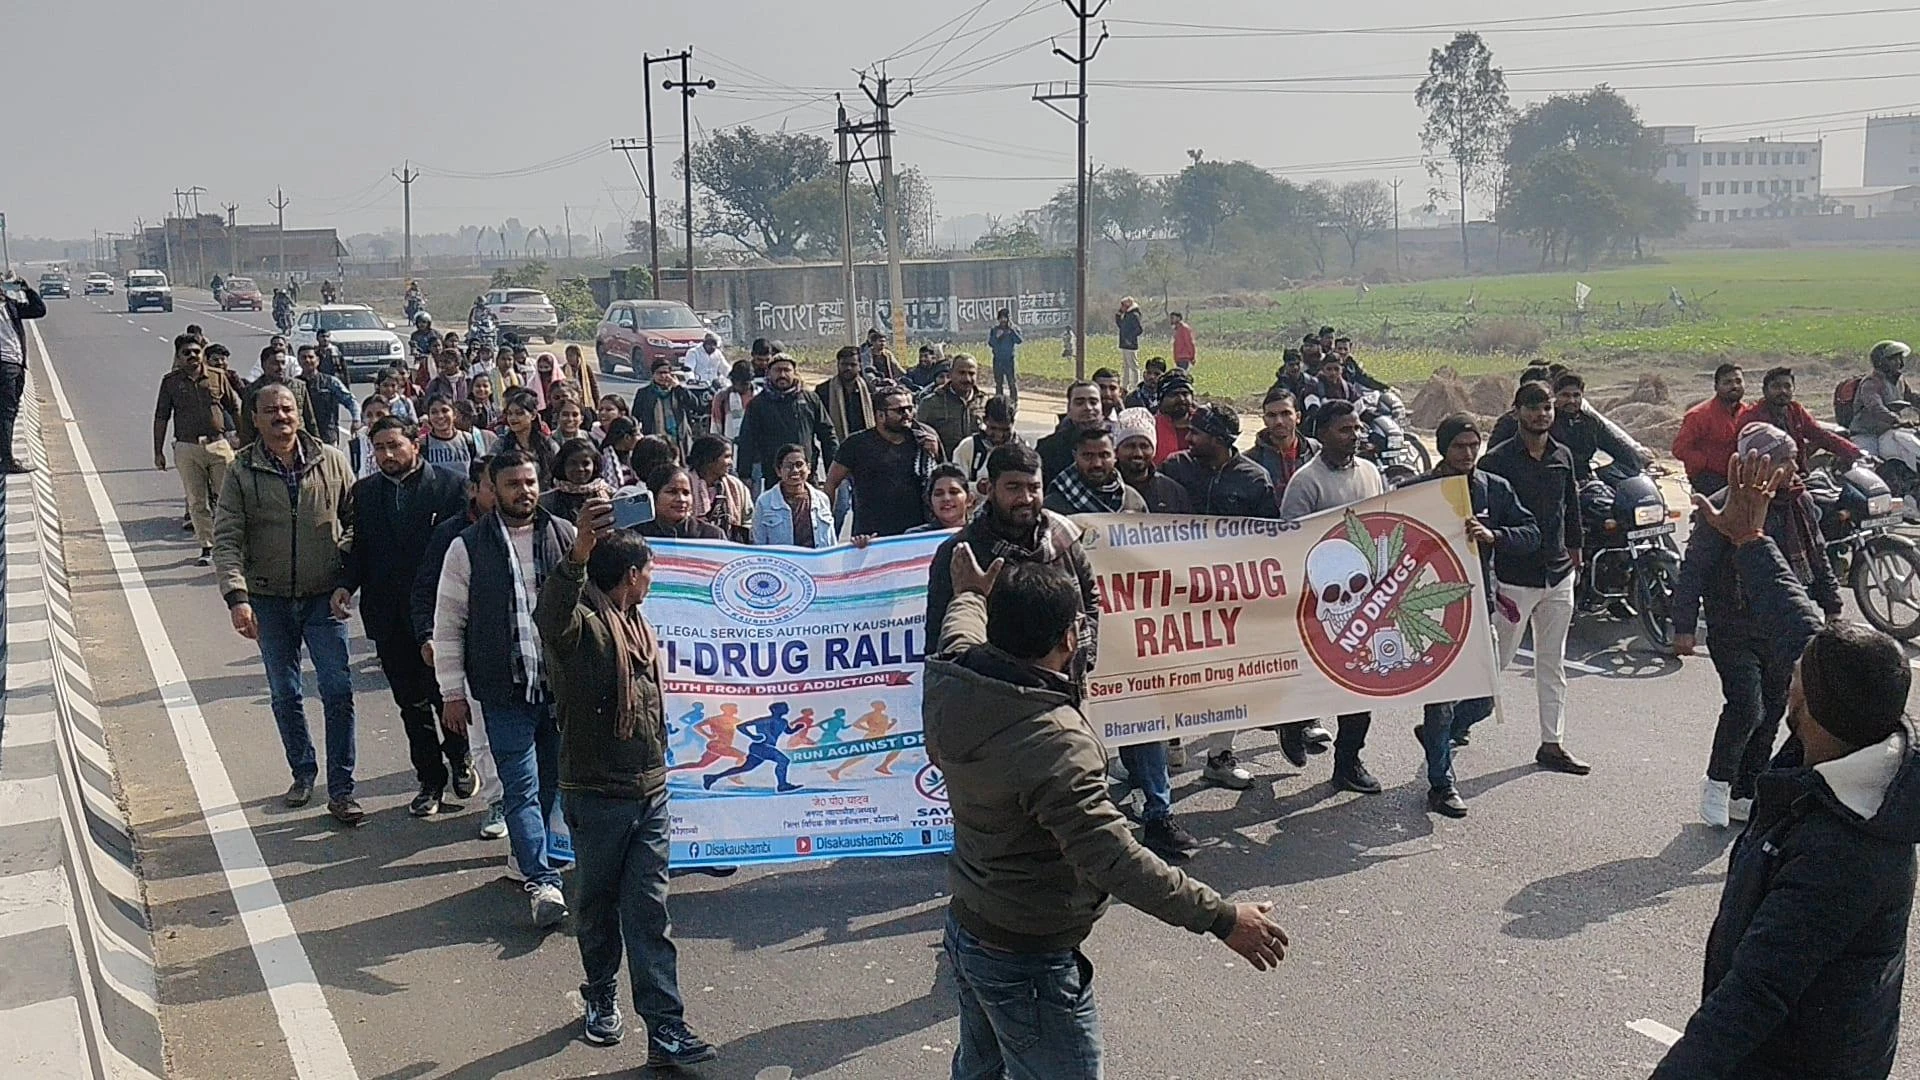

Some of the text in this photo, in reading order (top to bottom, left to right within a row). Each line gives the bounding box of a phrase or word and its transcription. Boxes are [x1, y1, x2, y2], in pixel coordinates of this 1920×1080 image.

[754, 301, 818, 331] निराश
[1108, 520, 1208, 548] Maharishi
[1338, 553, 1418, 653] NO DRUGS
[666, 625, 707, 638] LEGAL
[710, 627, 773, 639] SERVICES
[777, 623, 850, 638] AUTHORITY
[853, 614, 926, 632] KAUSHAMBI
[1134, 606, 1243, 658] RALLY
[825, 629, 926, 672] RALL
[705, 684, 750, 694] FROM
[755, 682, 799, 694] DRUG
[802, 673, 890, 691] ADDICTION!
[1090, 657, 1299, 698] Save Youth From Drug Addiction
[1104, 704, 1248, 738] Bharwari, Kaushambi
[793, 750, 823, 761] RUN
[827, 737, 898, 757] AGAINST
[910, 819, 928, 827] TO
[917, 807, 951, 817] SAY
